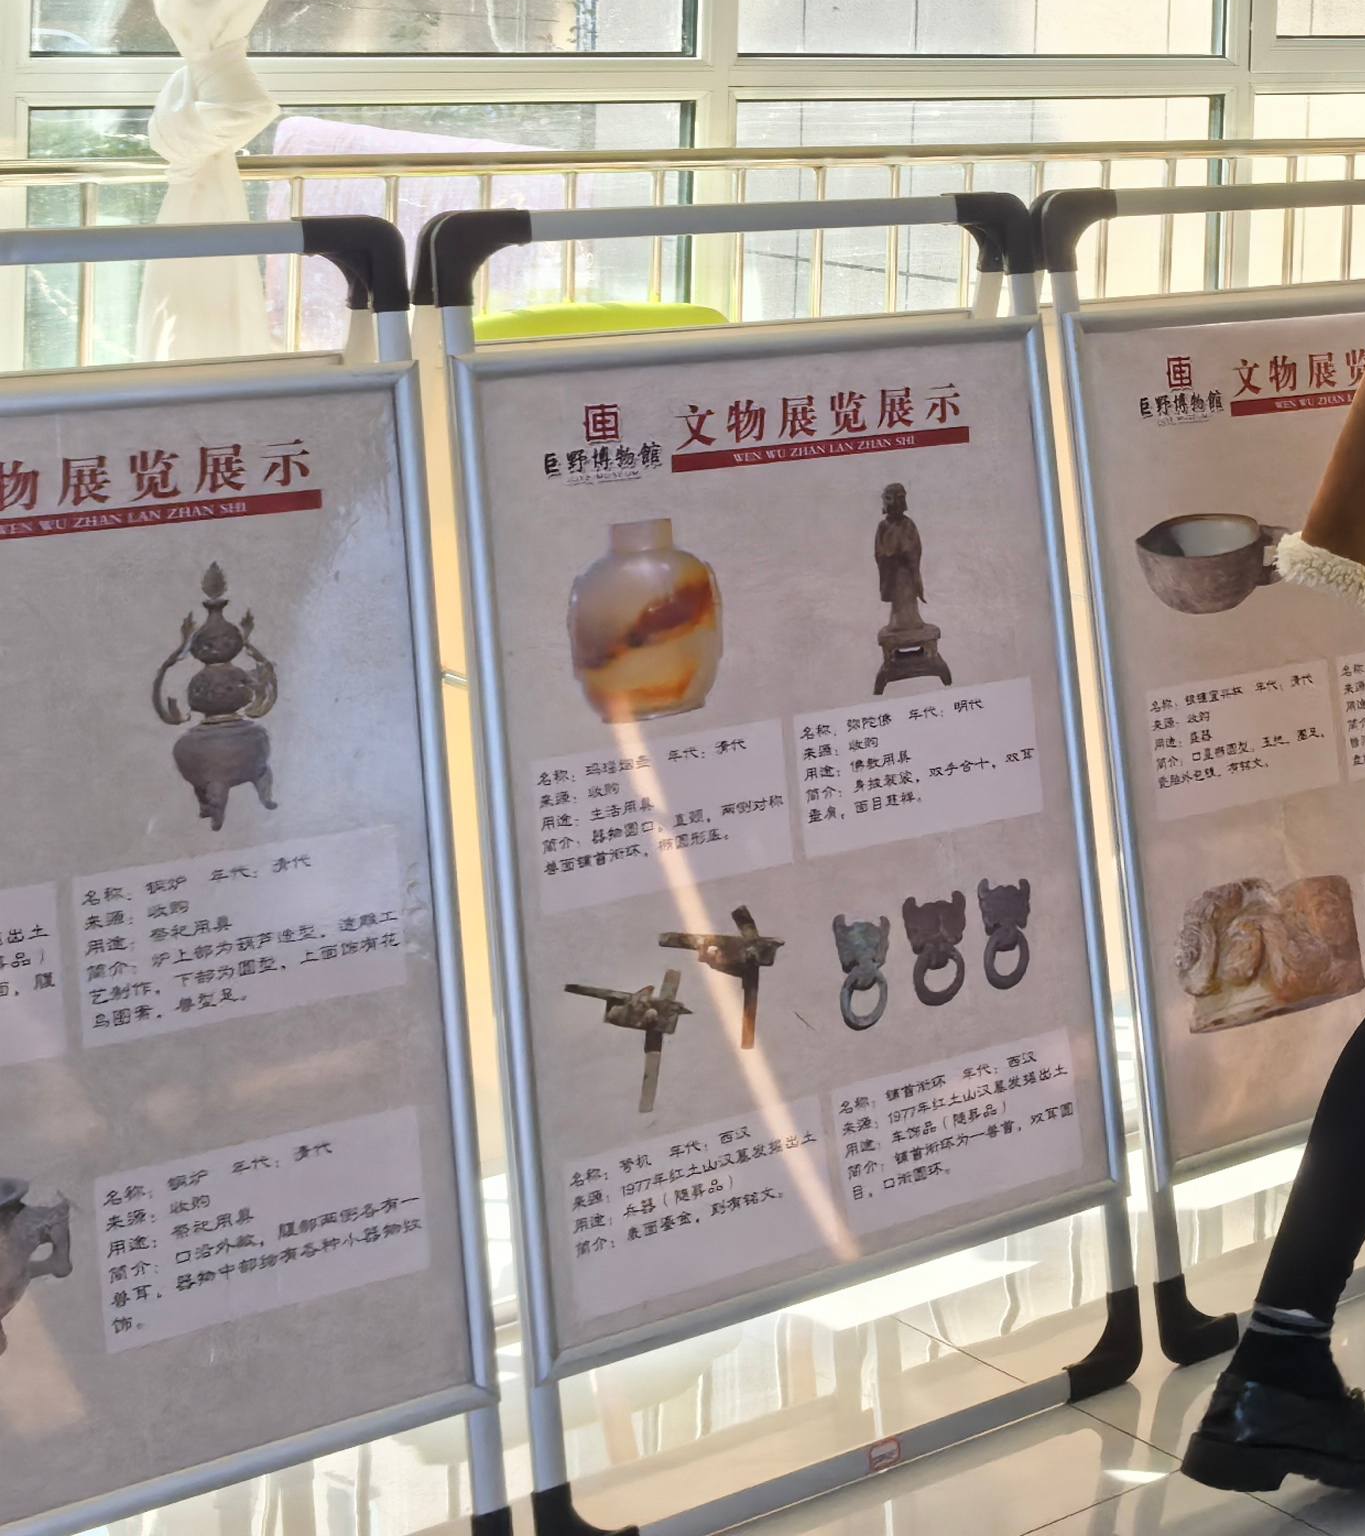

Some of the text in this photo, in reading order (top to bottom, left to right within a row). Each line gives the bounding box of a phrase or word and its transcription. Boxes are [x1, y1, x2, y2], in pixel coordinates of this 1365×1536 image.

[674, 383, 961, 451] 文物展览展示
[733, 435, 916, 464] WEN WU ZHAN LAN ZHAN SHI
[38, 517, 67, 531] WU
[73, 513, 123, 528] ZHAN
[128, 509, 161, 523] LAN
[167, 504, 215, 519] ZHAN
[220, 501, 247, 514] SHI
[0, 921, 50, 946] 出土
